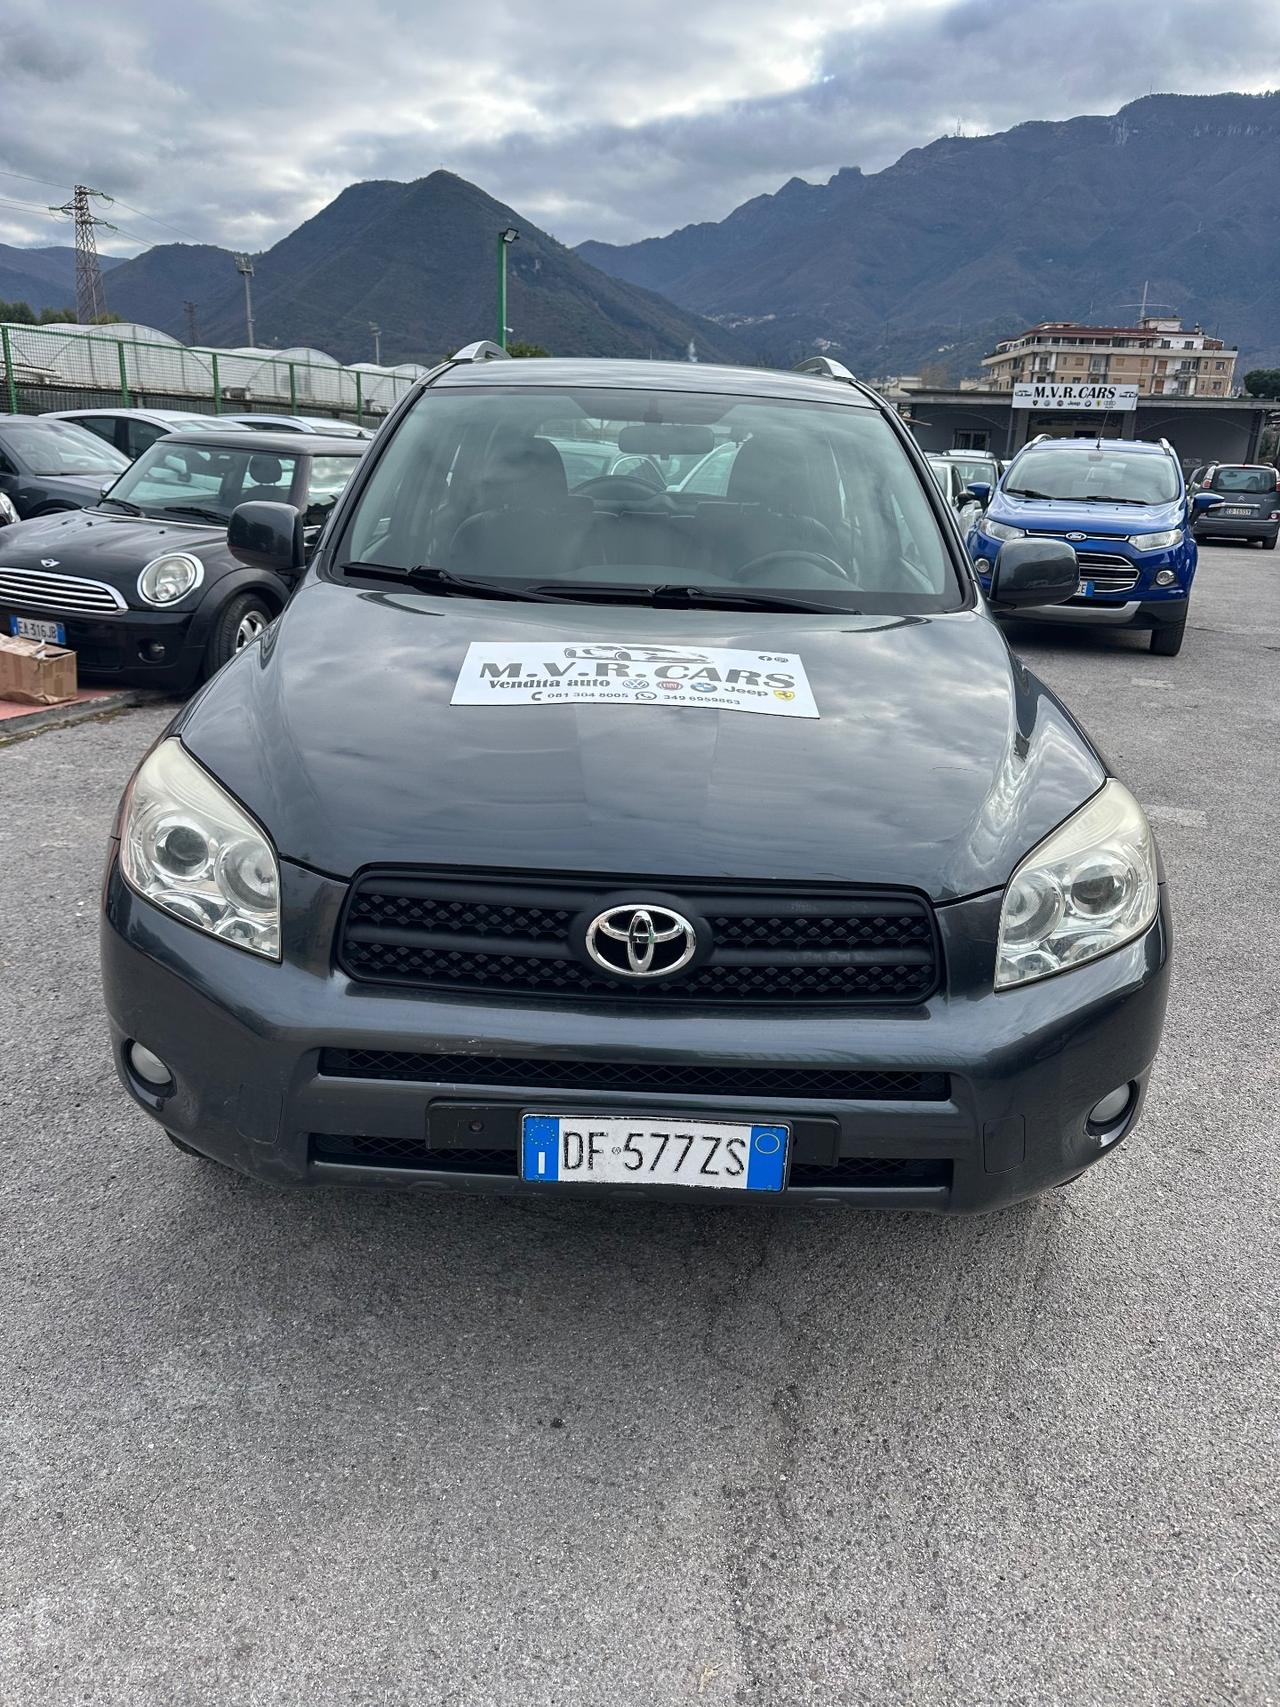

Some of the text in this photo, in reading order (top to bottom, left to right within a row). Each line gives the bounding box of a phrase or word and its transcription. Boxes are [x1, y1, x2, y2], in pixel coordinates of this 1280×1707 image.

[17, 620, 28, 634] EA
[567, 679, 611, 687] auto
[723, 686, 769, 697] Jeep
[563, 1131, 609, 1170] DF
[622, 1132, 747, 1176] 577ZS
